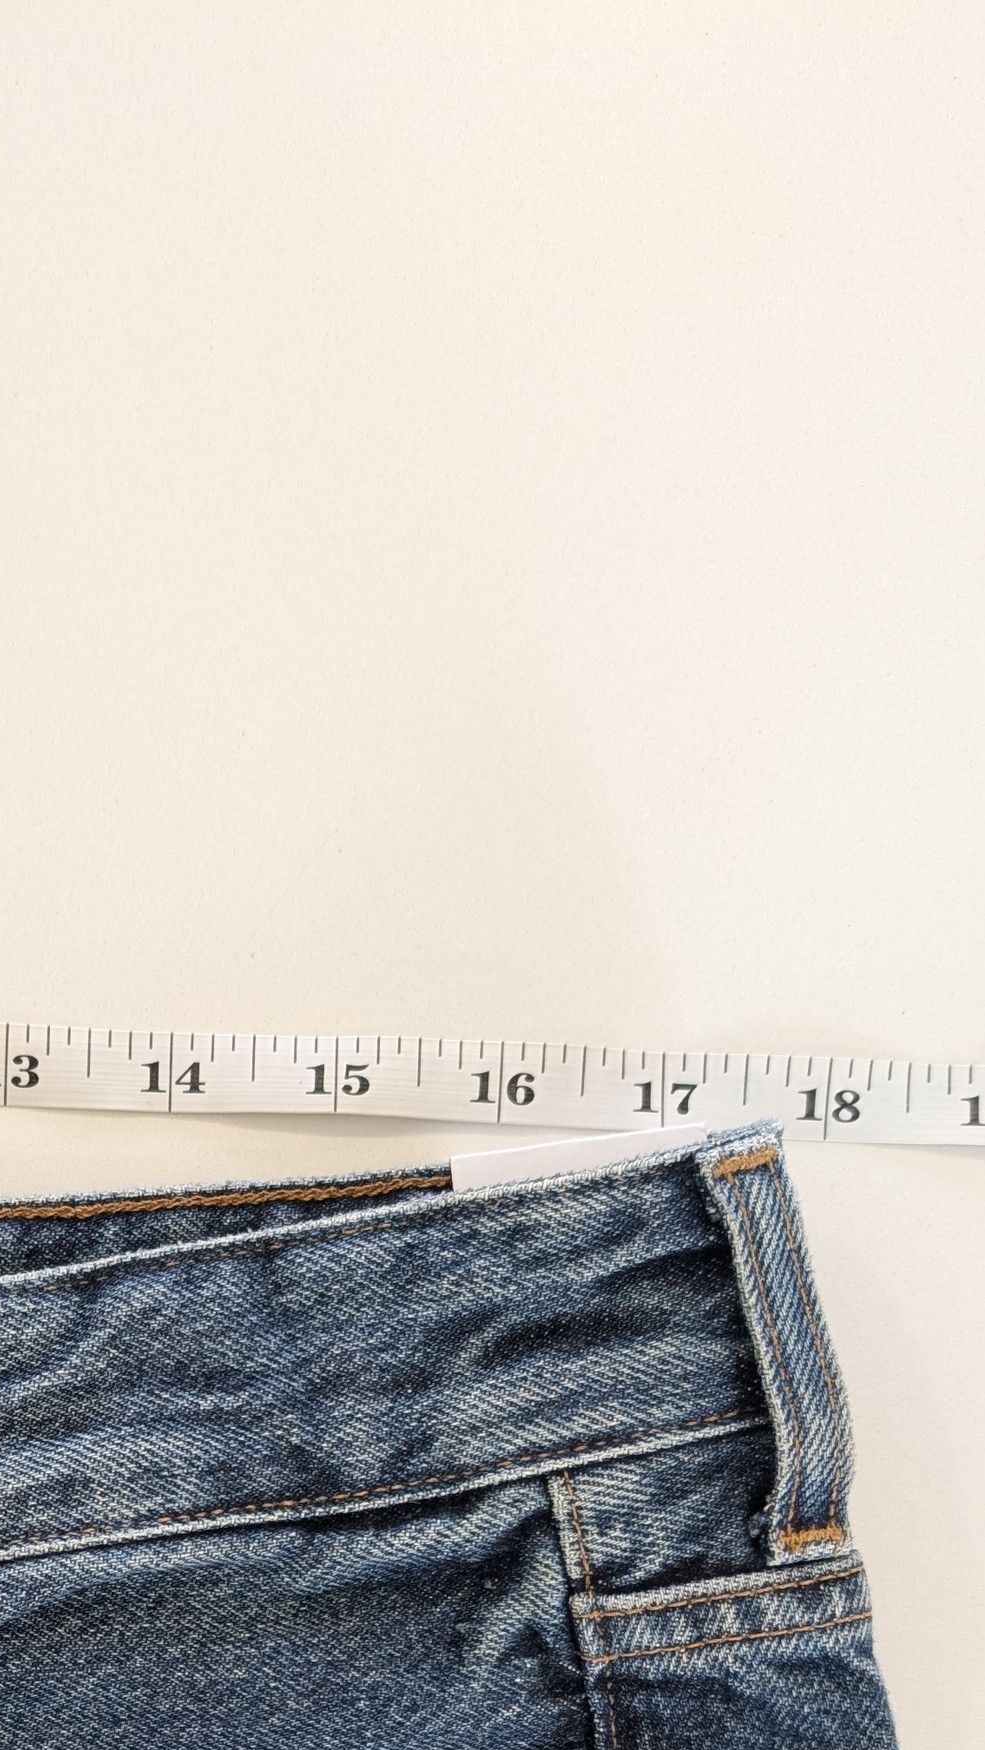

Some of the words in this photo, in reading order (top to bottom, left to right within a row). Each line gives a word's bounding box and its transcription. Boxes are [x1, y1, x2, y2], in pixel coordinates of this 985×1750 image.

[141, 1061, 205, 1094] 14
[305, 1064, 370, 1096] 15
[469, 1070, 535, 1106] 16
[633, 1081, 698, 1115] 17
[797, 1088, 860, 1123] 18
